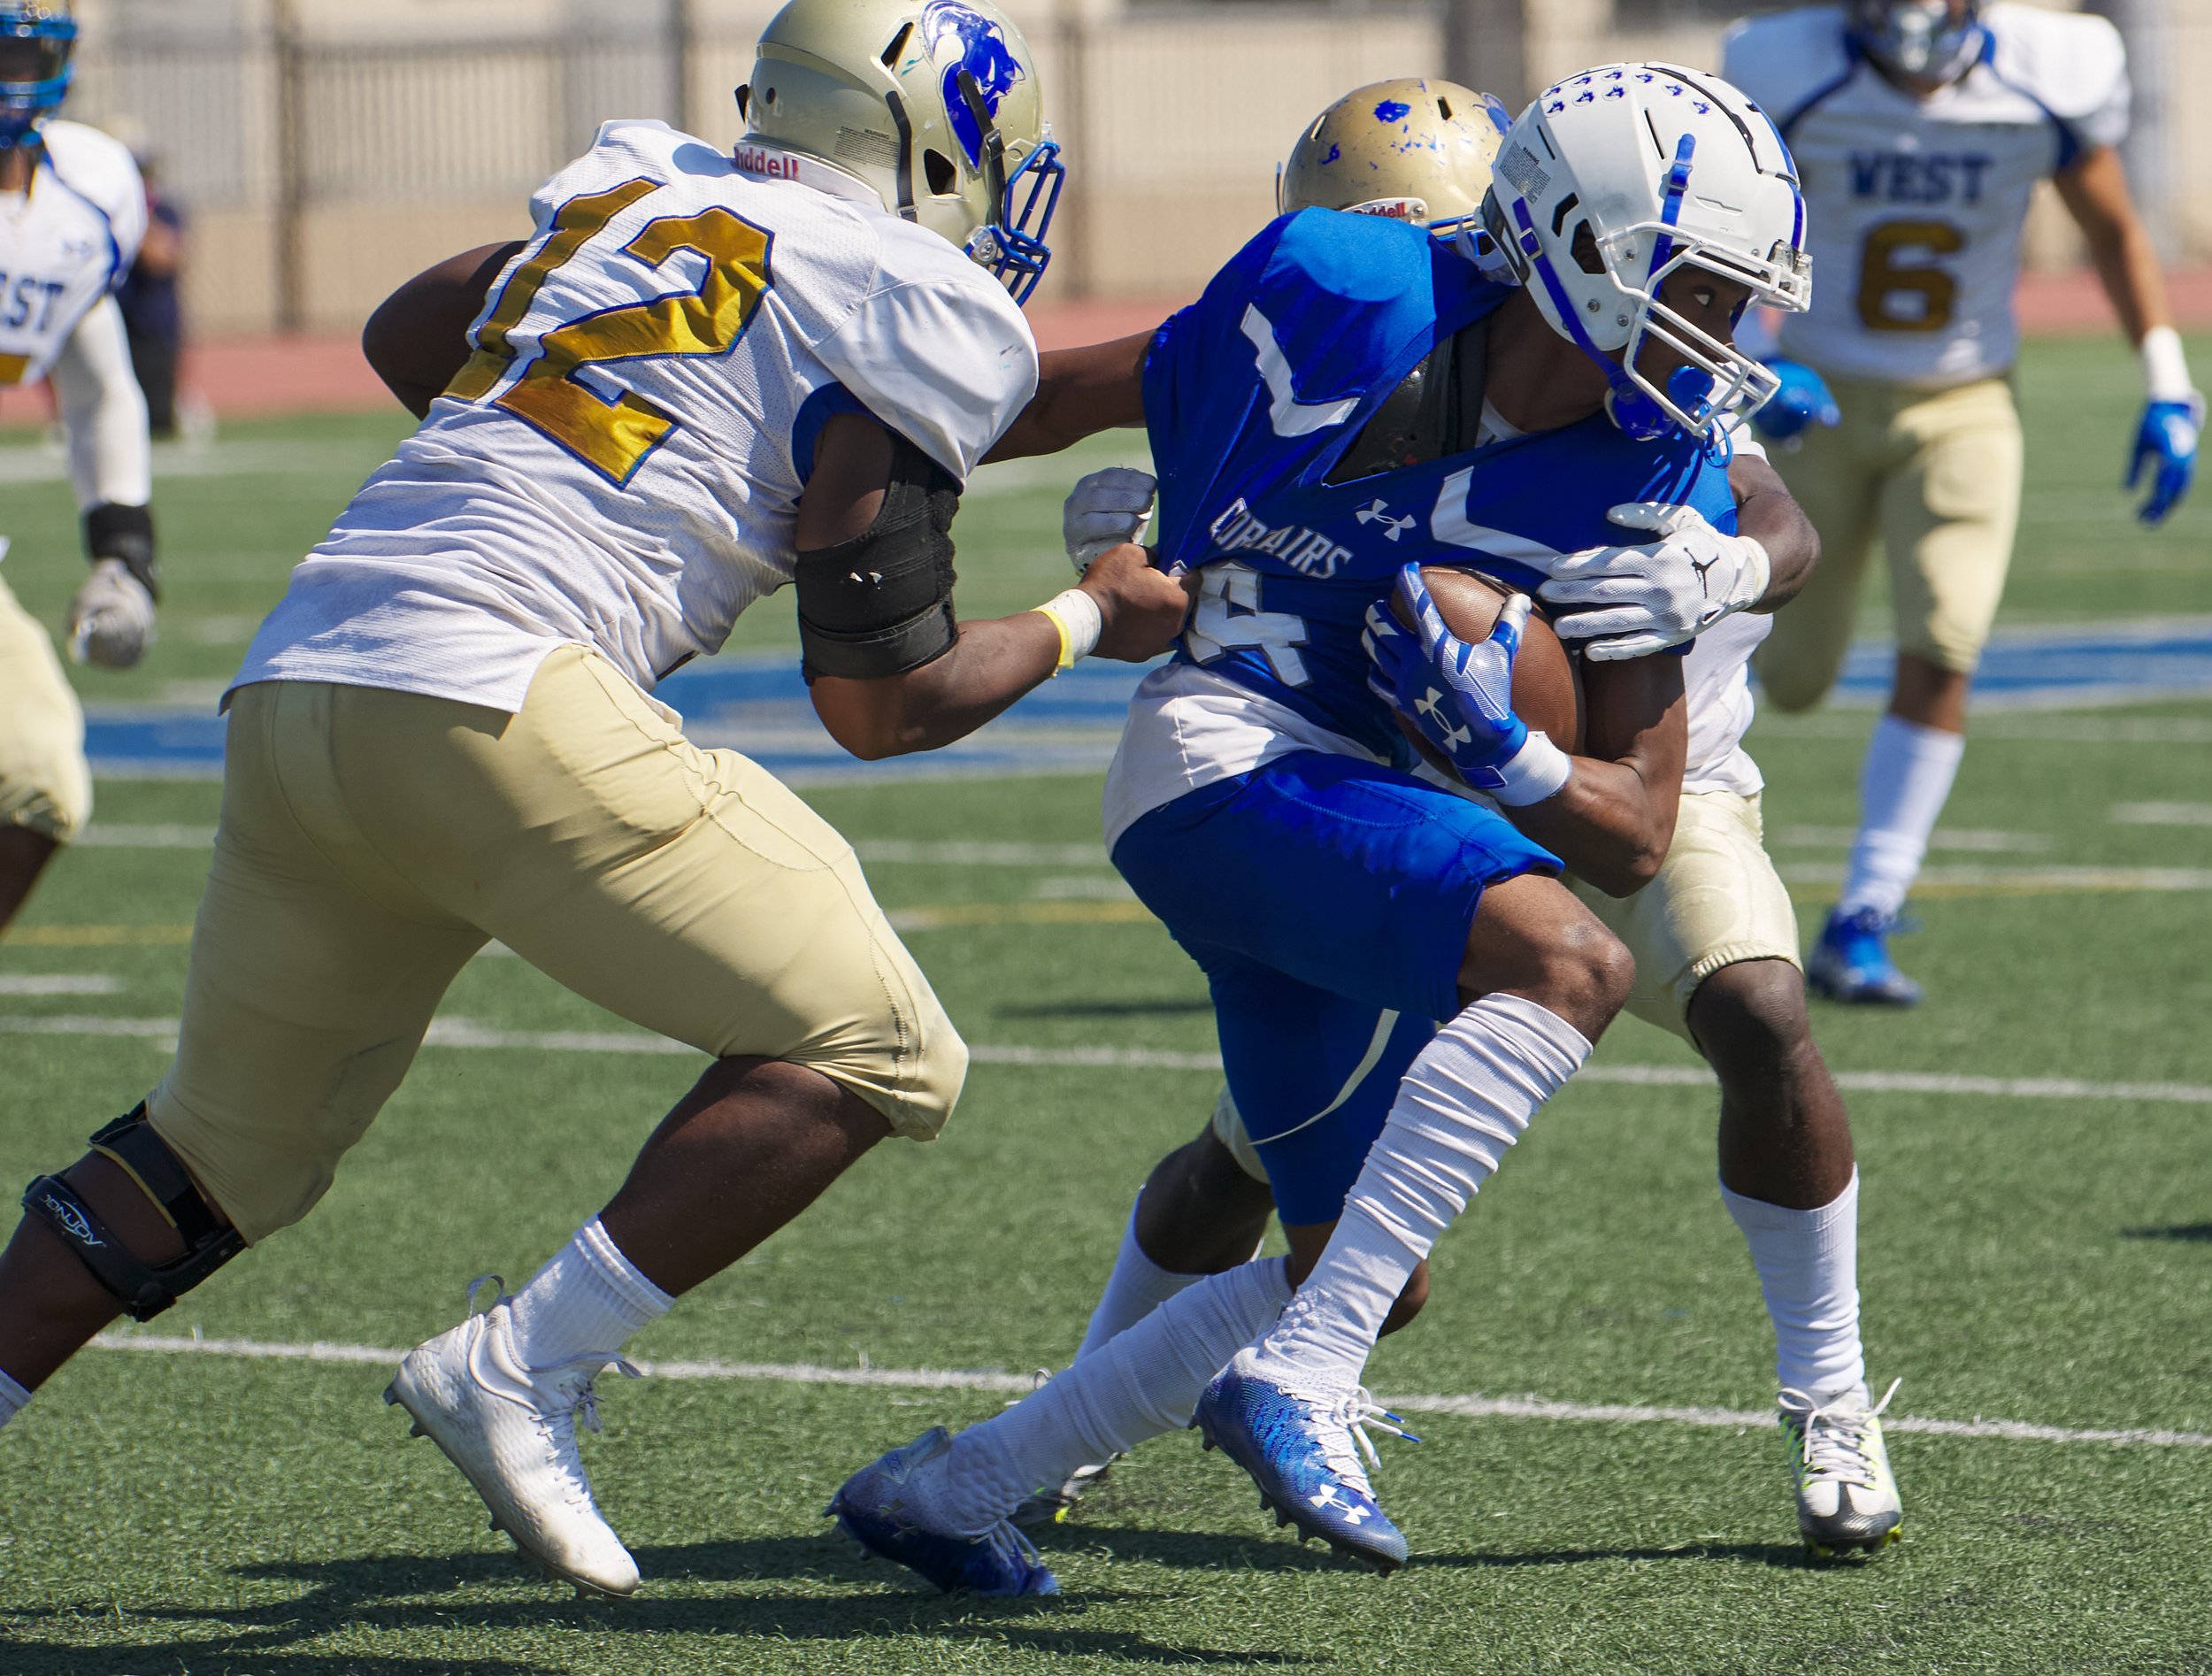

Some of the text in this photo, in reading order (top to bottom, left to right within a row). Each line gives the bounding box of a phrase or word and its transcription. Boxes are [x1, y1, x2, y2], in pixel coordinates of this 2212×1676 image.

[1353, 202, 1406, 219] ddell
[1857, 219, 1966, 332] 6
[442, 175, 777, 491] 12
